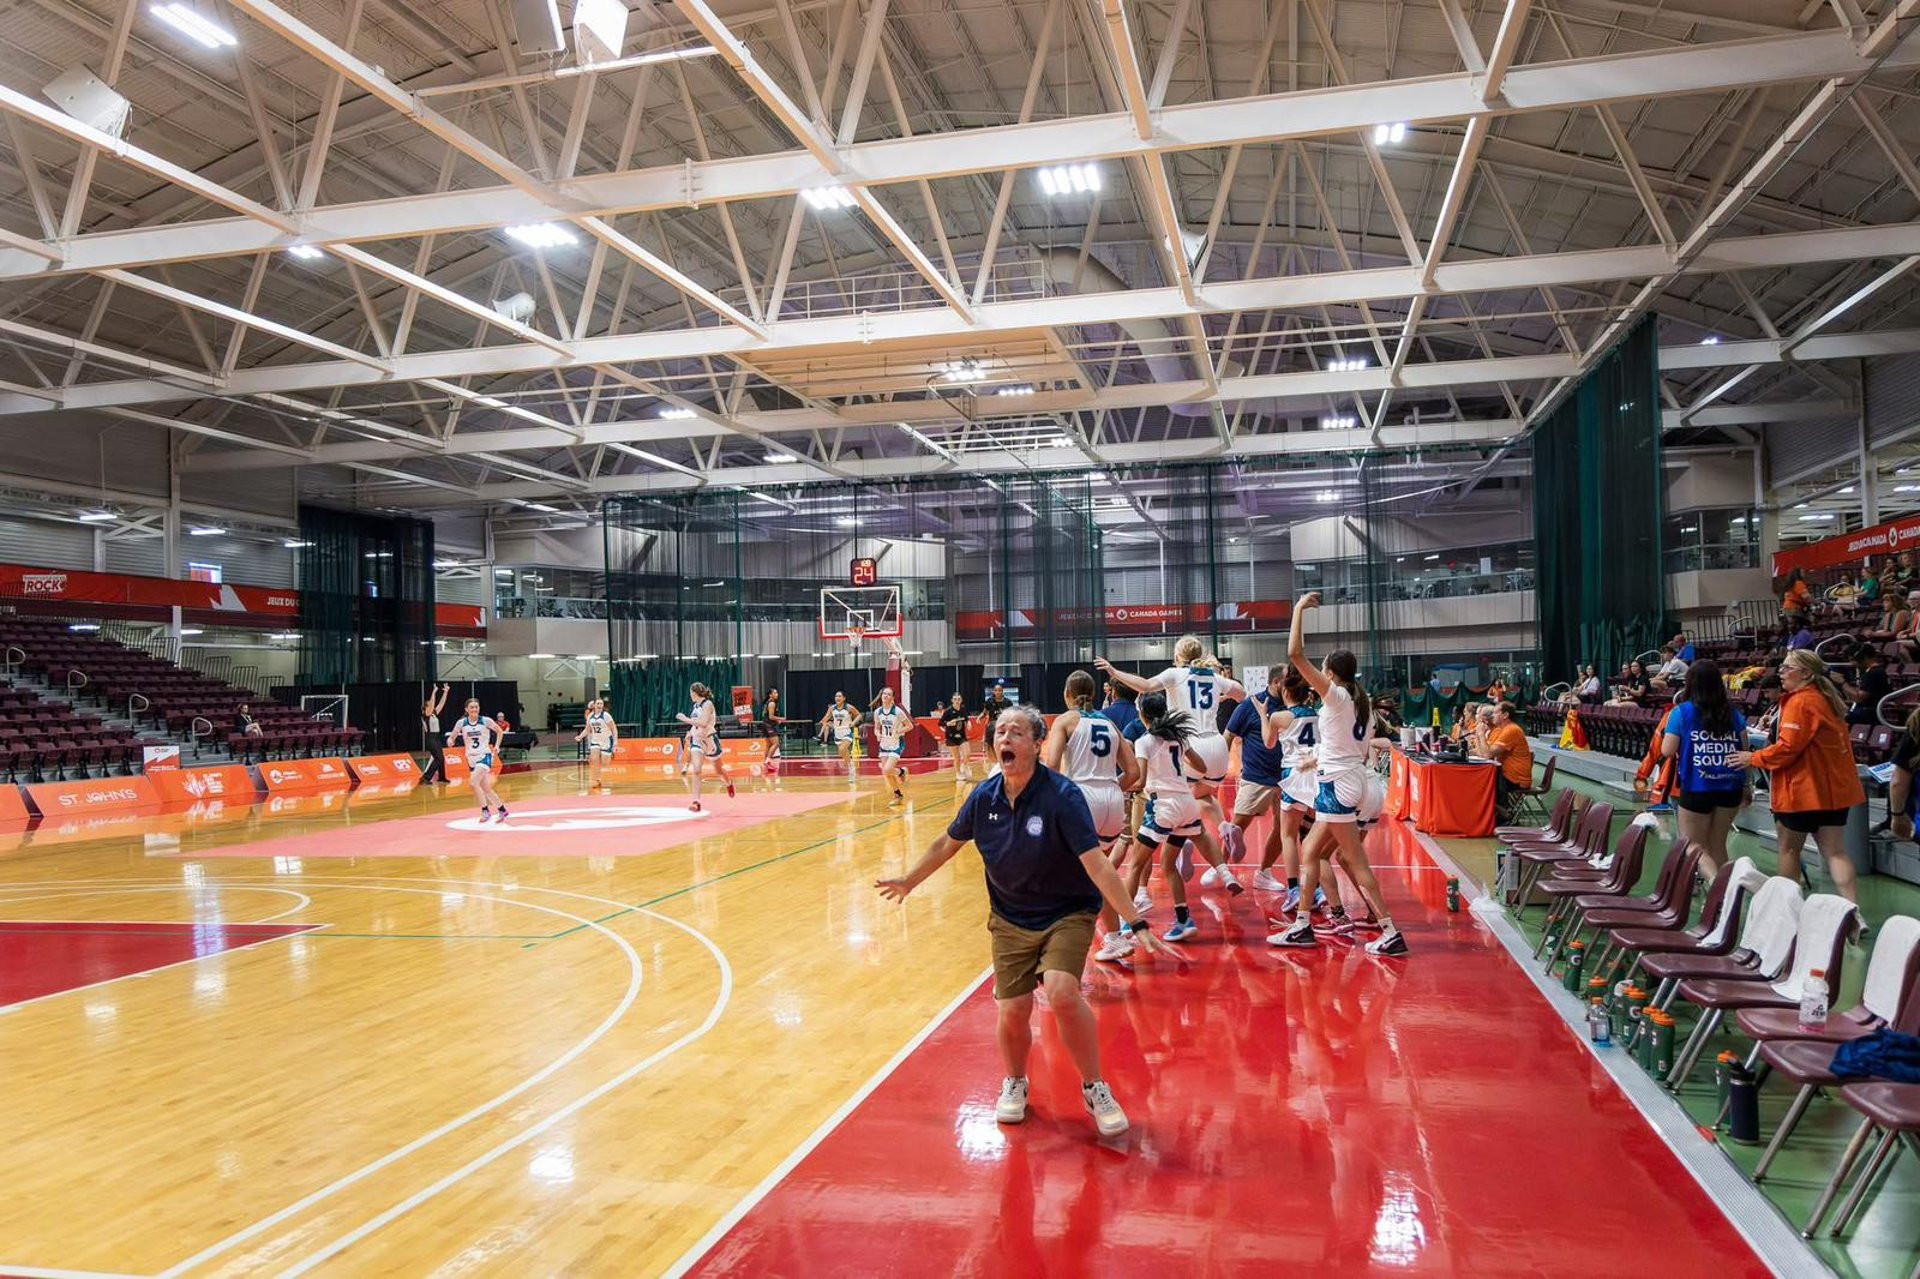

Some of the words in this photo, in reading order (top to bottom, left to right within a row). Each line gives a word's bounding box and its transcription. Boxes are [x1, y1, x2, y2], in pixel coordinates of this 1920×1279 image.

[854, 566, 873, 584] 24
[26, 580, 60, 591] ROCK
[1130, 610, 1158, 618] CANADA
[1188, 680, 1213, 709] 13
[1090, 724, 1111, 757] 5
[1299, 722, 1315, 746] 4
[472, 737, 480, 749] 3
[1693, 742, 1737, 753] MEDIA
[1169, 745, 1182, 777] 1
[1693, 755, 1729, 767] SQUA
